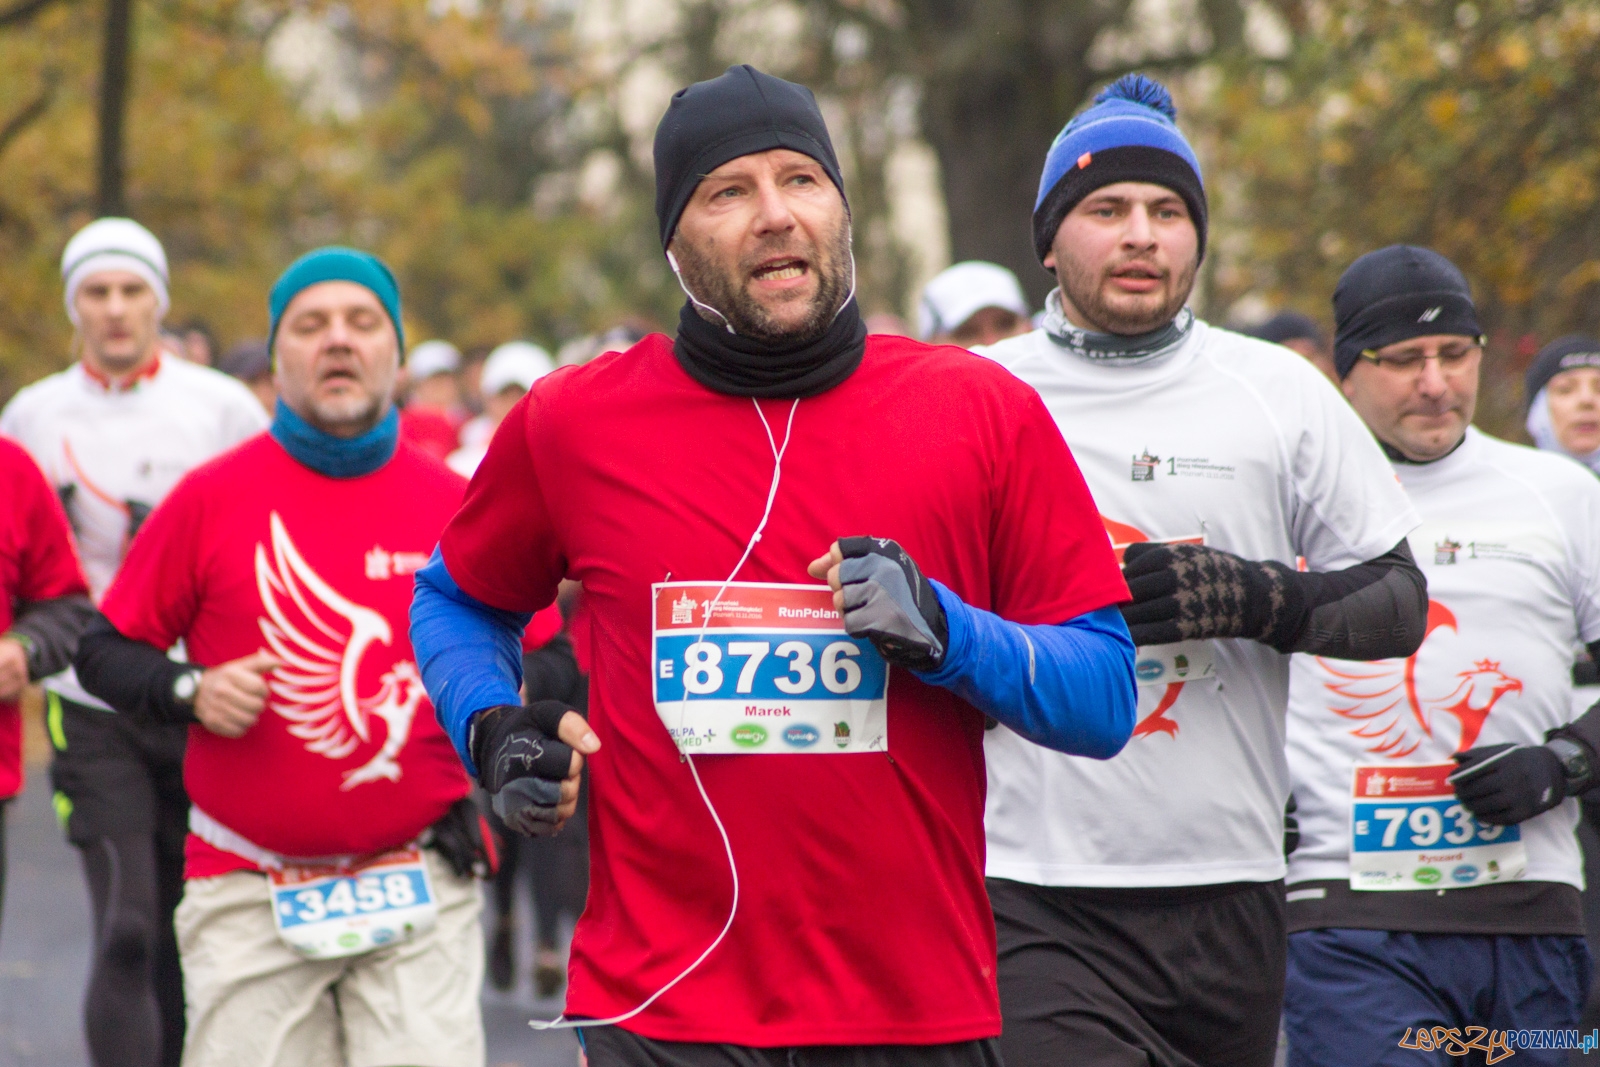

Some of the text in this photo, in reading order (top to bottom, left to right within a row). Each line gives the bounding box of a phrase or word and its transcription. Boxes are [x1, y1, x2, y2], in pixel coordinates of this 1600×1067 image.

[660, 640, 862, 695] E 8736
[744, 705, 791, 717] Marek
[1356, 820, 1369, 835] E
[1418, 852, 1464, 864] Ryszard
[294, 872, 416, 922] 3458
